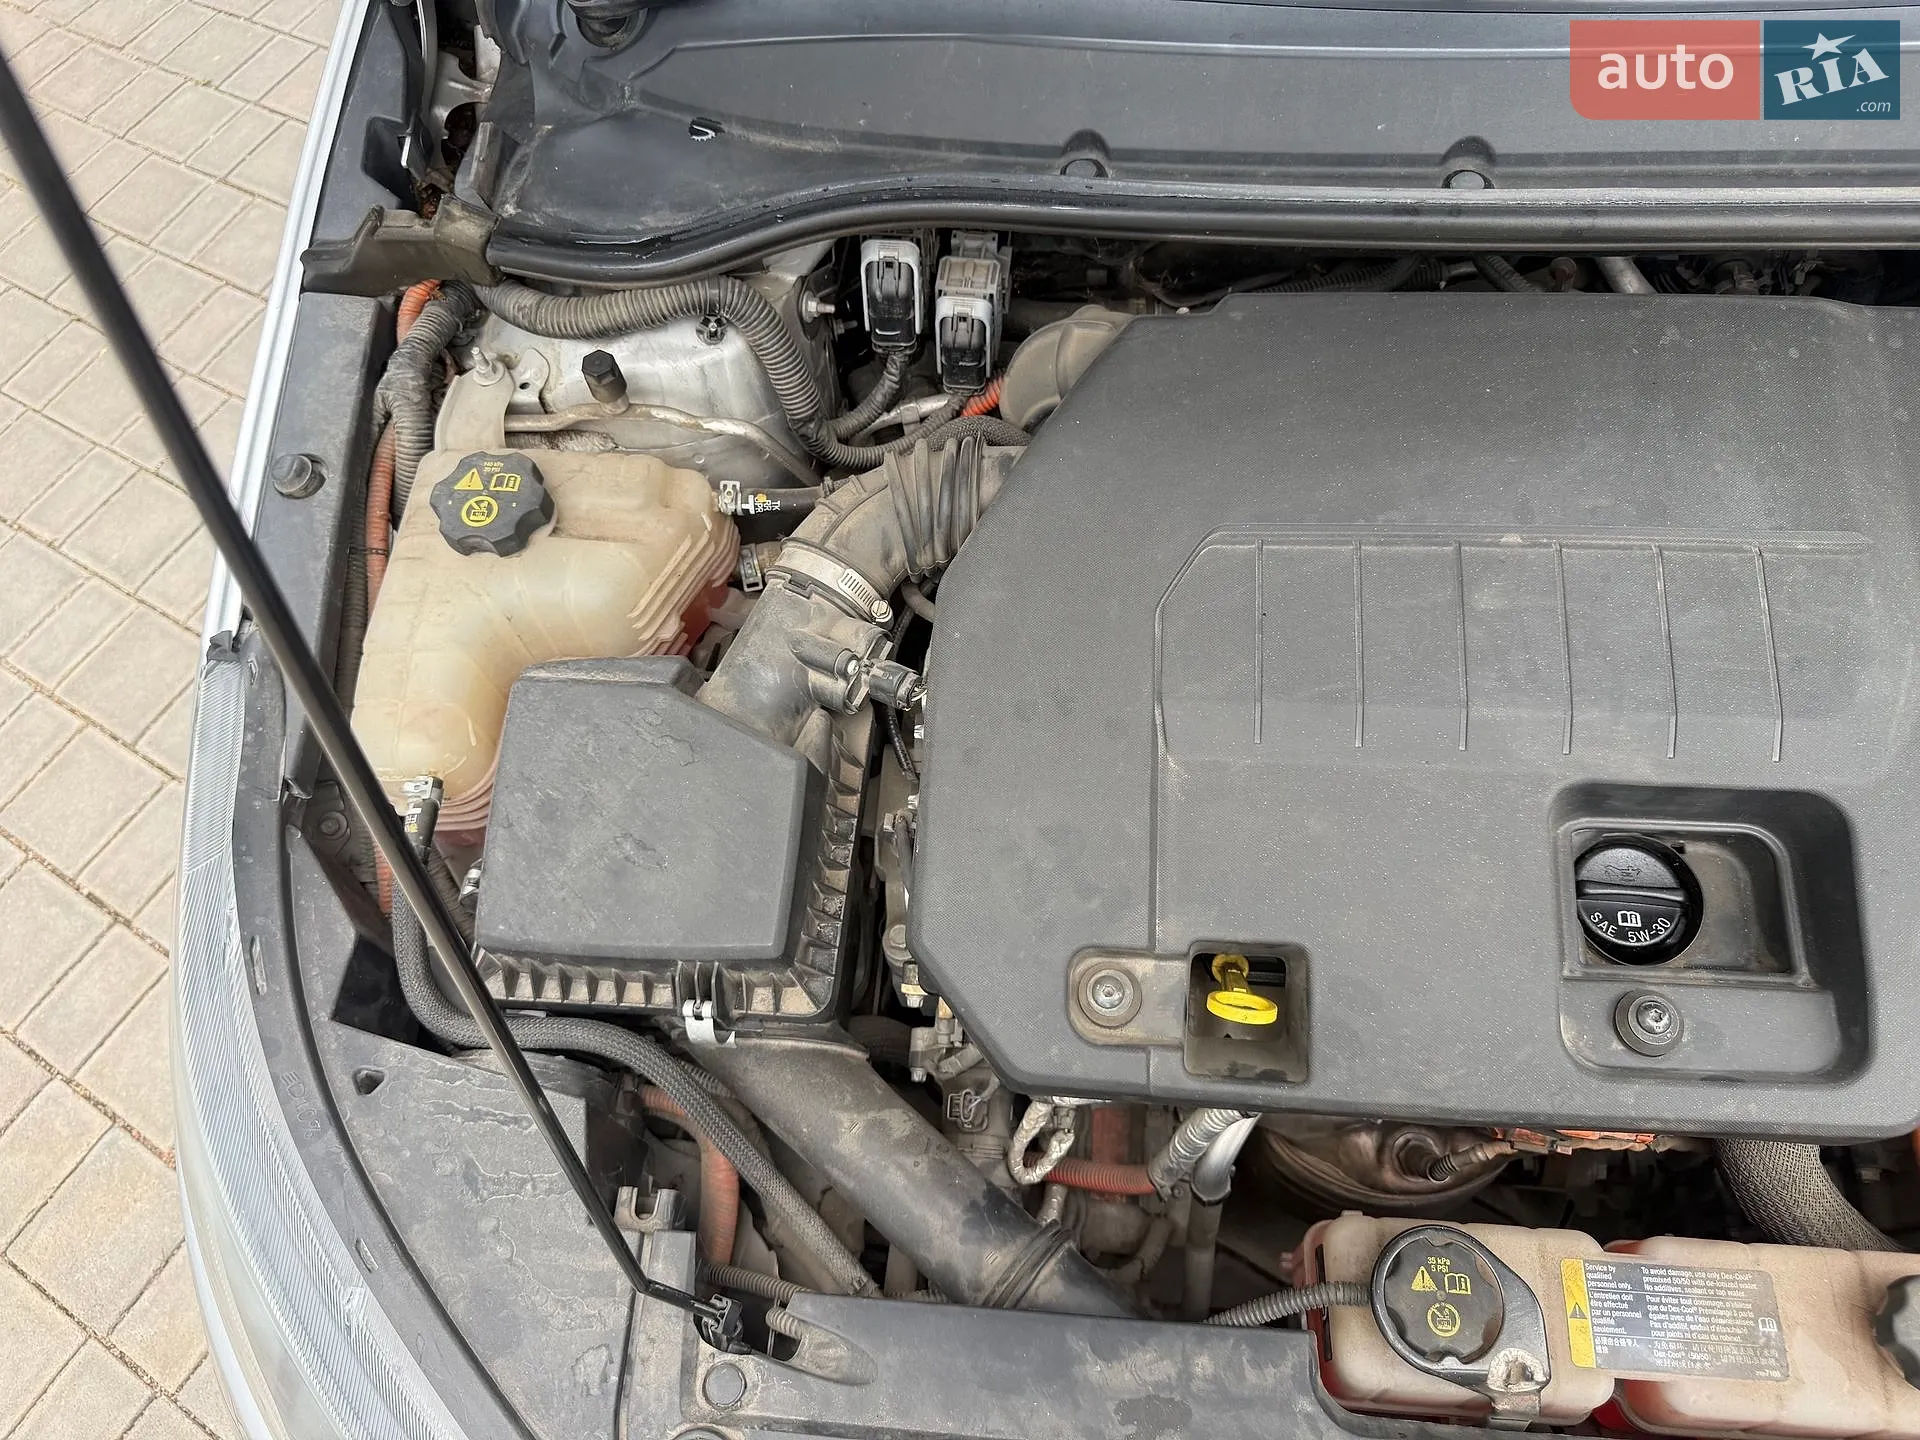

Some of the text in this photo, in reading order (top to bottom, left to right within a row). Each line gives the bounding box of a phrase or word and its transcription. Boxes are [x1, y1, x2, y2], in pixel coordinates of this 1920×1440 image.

[1590, 911, 1618, 937] SAE
[1627, 917, 1671, 943] 5W-30
[1427, 1256, 1451, 1265] 35 kPa
[1431, 1264, 1449, 1273] 5 PSI
[1585, 1263, 1616, 1273] Service by
[1641, 1266, 1649, 1274] To
[1650, 1268, 1666, 1276] avoid
[1586, 1272, 1612, 1280] qualified
[1587, 1280, 1617, 1289] personnel
[1621, 1293, 1633, 1301] doit
[1611, 1310, 1642, 1318] personnel
[1651, 1330, 1666, 1338] pour
